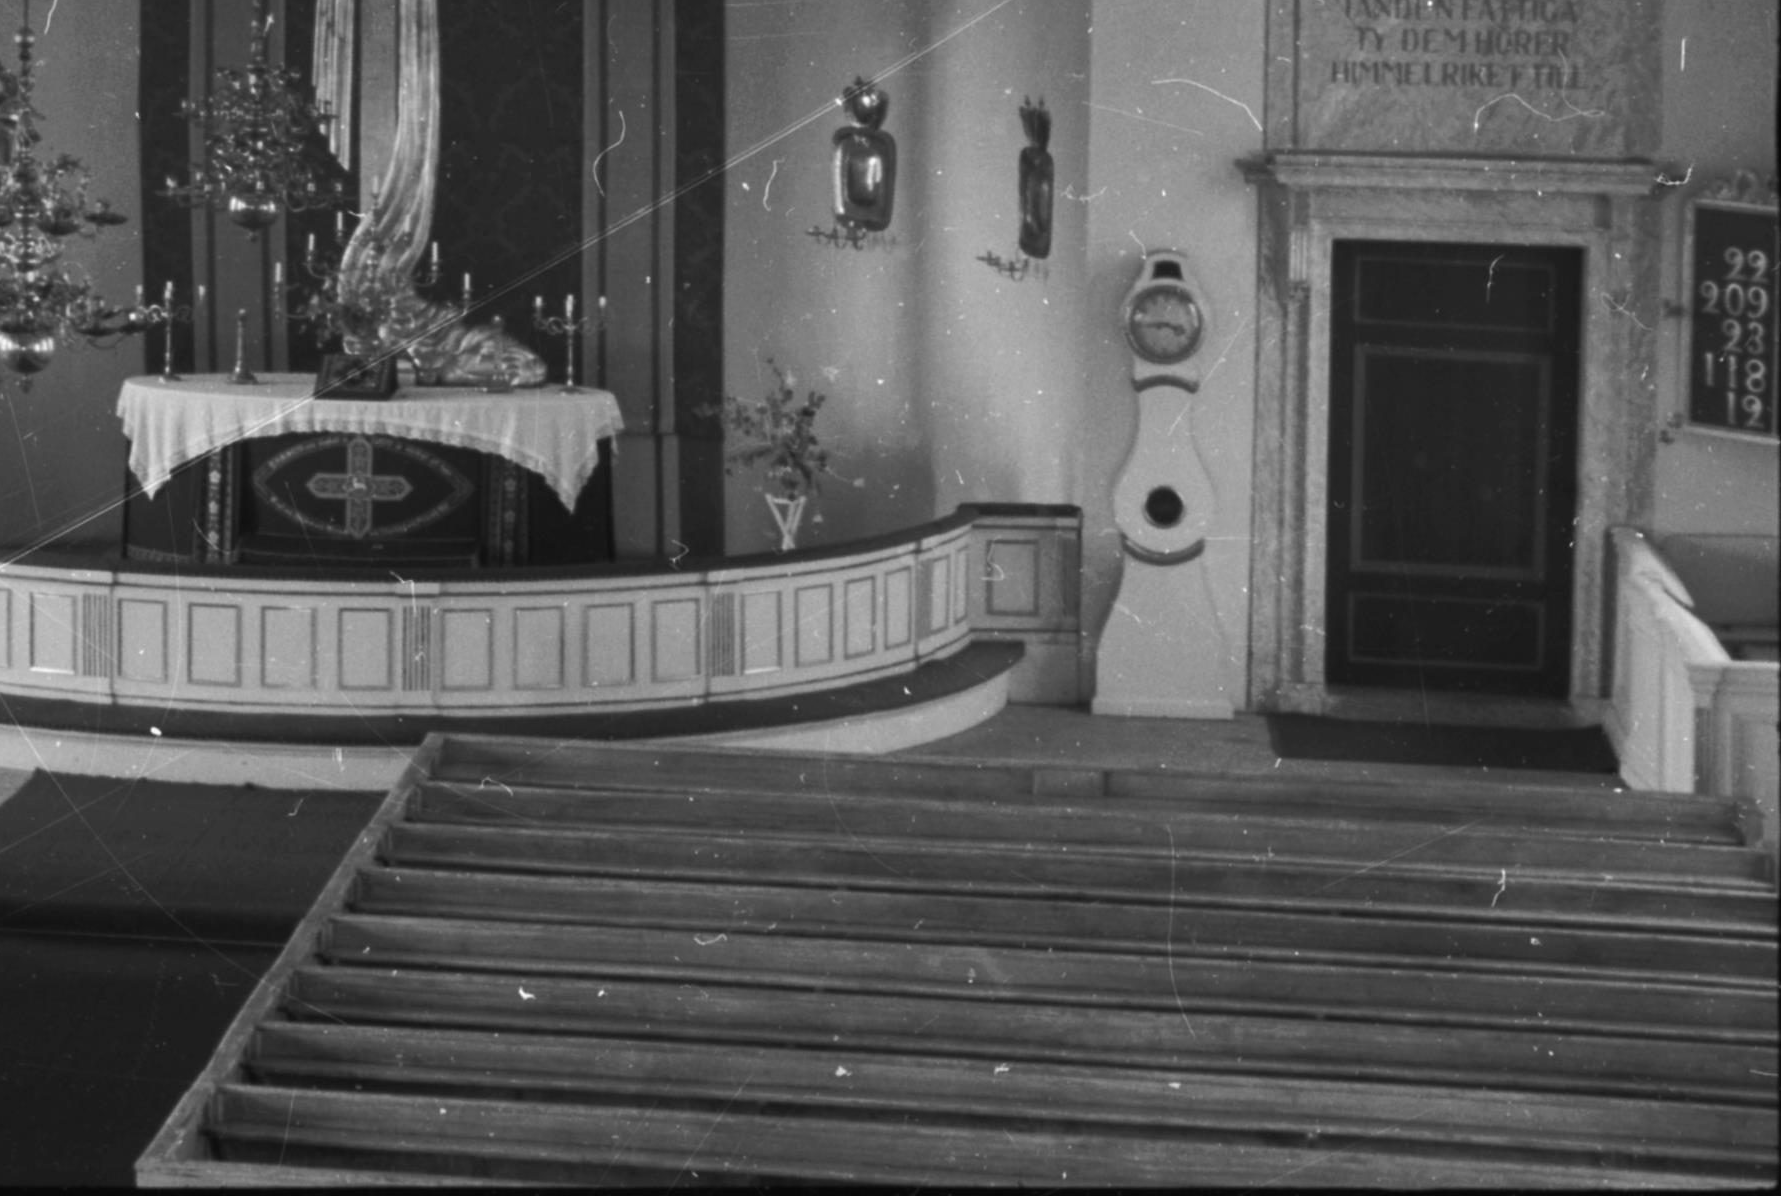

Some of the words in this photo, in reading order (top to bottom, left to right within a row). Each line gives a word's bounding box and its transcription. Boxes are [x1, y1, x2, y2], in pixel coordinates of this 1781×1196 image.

[1355, 25, 1384, 52] TY
[1400, 27, 1467, 54] DEM
[1723, 246, 1769, 282] 22
[1699, 280, 1768, 319] 209
[1722, 317, 1764, 355] 23
[1704, 351, 1766, 393] 118
[1726, 390, 1765, 428] 12
